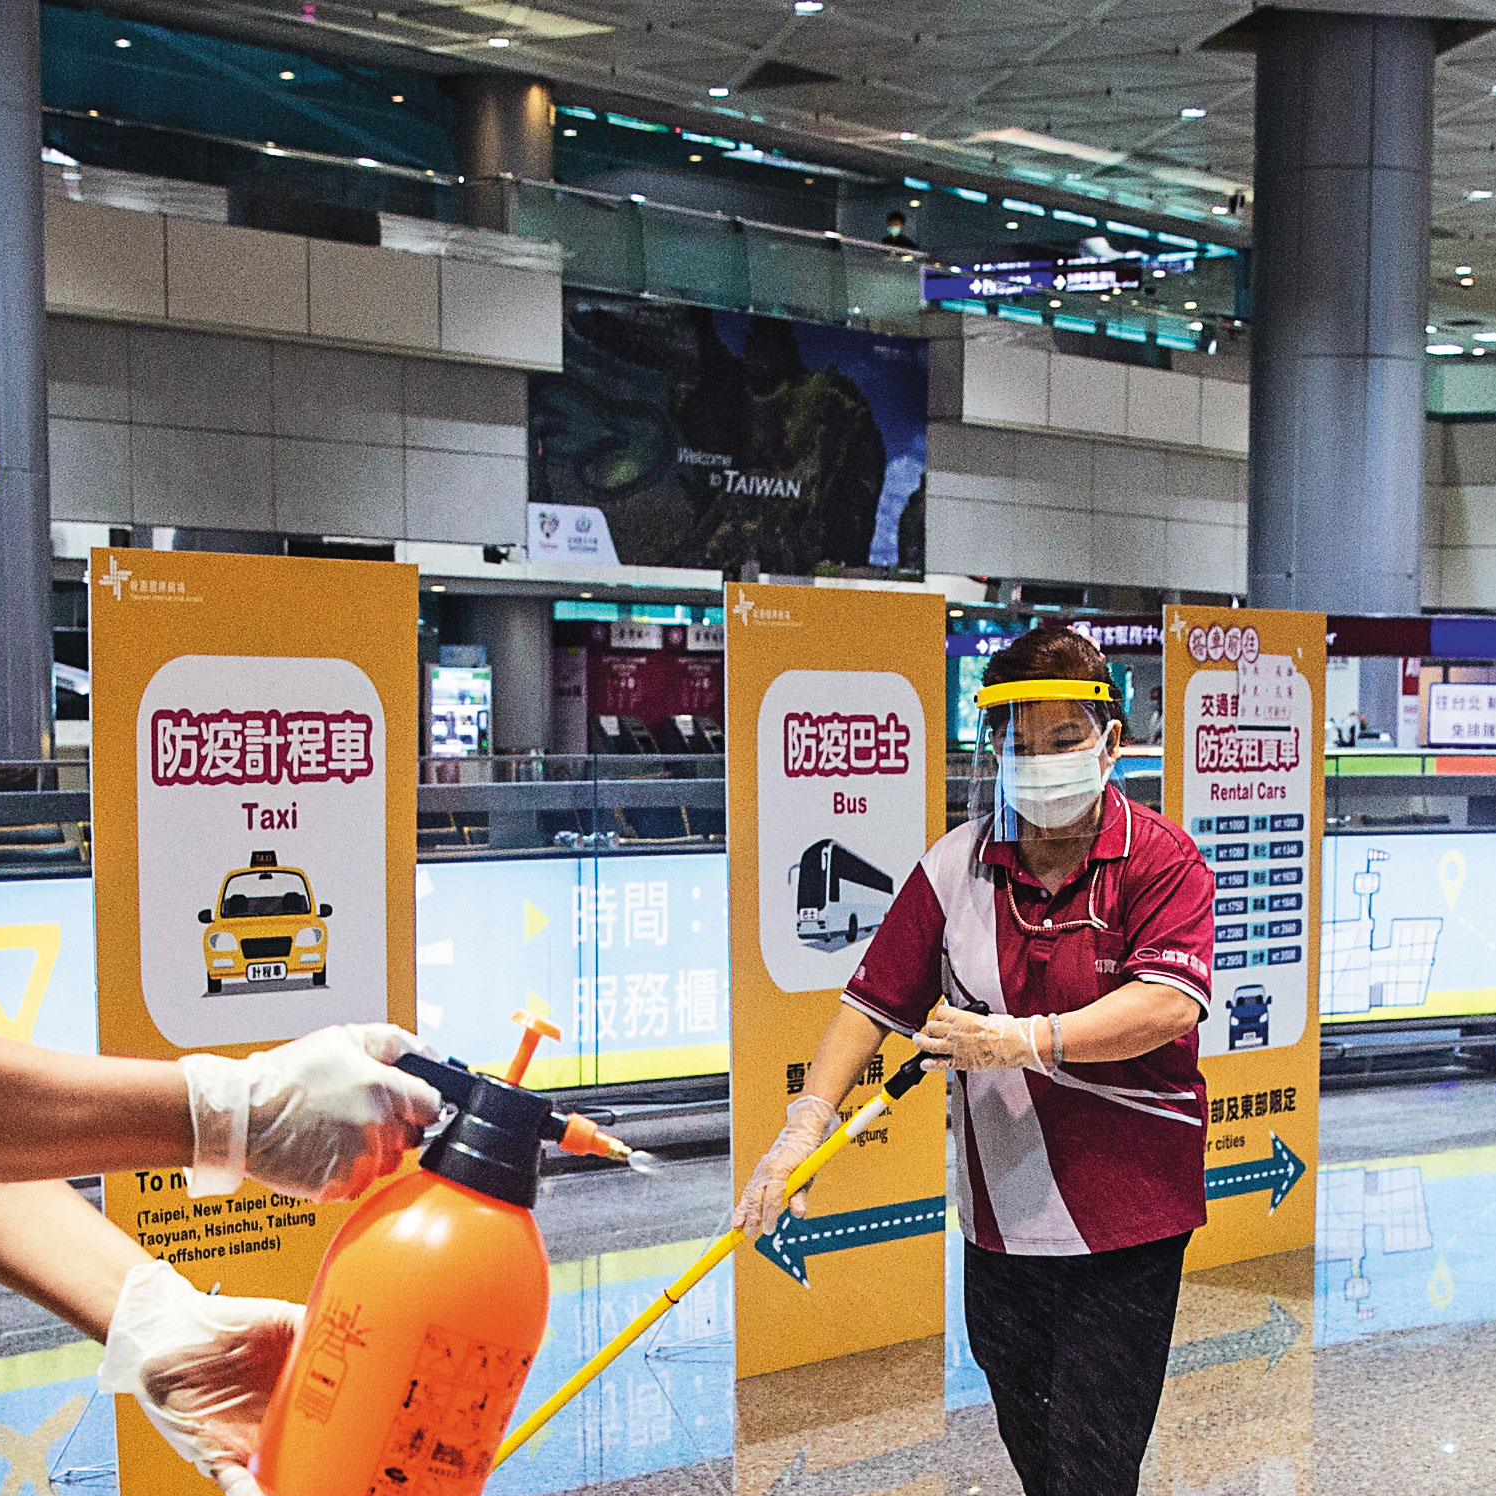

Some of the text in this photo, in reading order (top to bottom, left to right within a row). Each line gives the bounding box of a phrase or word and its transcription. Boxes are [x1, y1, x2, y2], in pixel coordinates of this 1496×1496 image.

[723, 469, 802, 500] TAIWAN
[153, 711, 372, 784] 防疫計程車
[785, 713, 910, 777] 防疫巴士
[833, 791, 867, 815] Bus
[1211, 781, 1286, 801] Rental Cars
[241, 802, 298, 831] Taxi
[255, 854, 273, 863] TAXI
[252, 965, 283, 979] 計程車
[572, 968, 729, 1042] 服務櫃
[1207, 1086, 1296, 1124] 部及東部限定
[1215, 1134, 1246, 1151] cities
[136, 1171, 163, 1194] To
[137, 1206, 190, 1228] (Taipei,
[193, 1203, 223, 1219] New
[226, 1195, 267, 1214] Taipei
[270, 1193, 301, 1209] City,
[138, 1211, 316, 1248] Taoyuan, Hsinchu, Taitung
[168, 1245, 225, 1265] offshore
[229, 1235, 281, 1256] islands)
